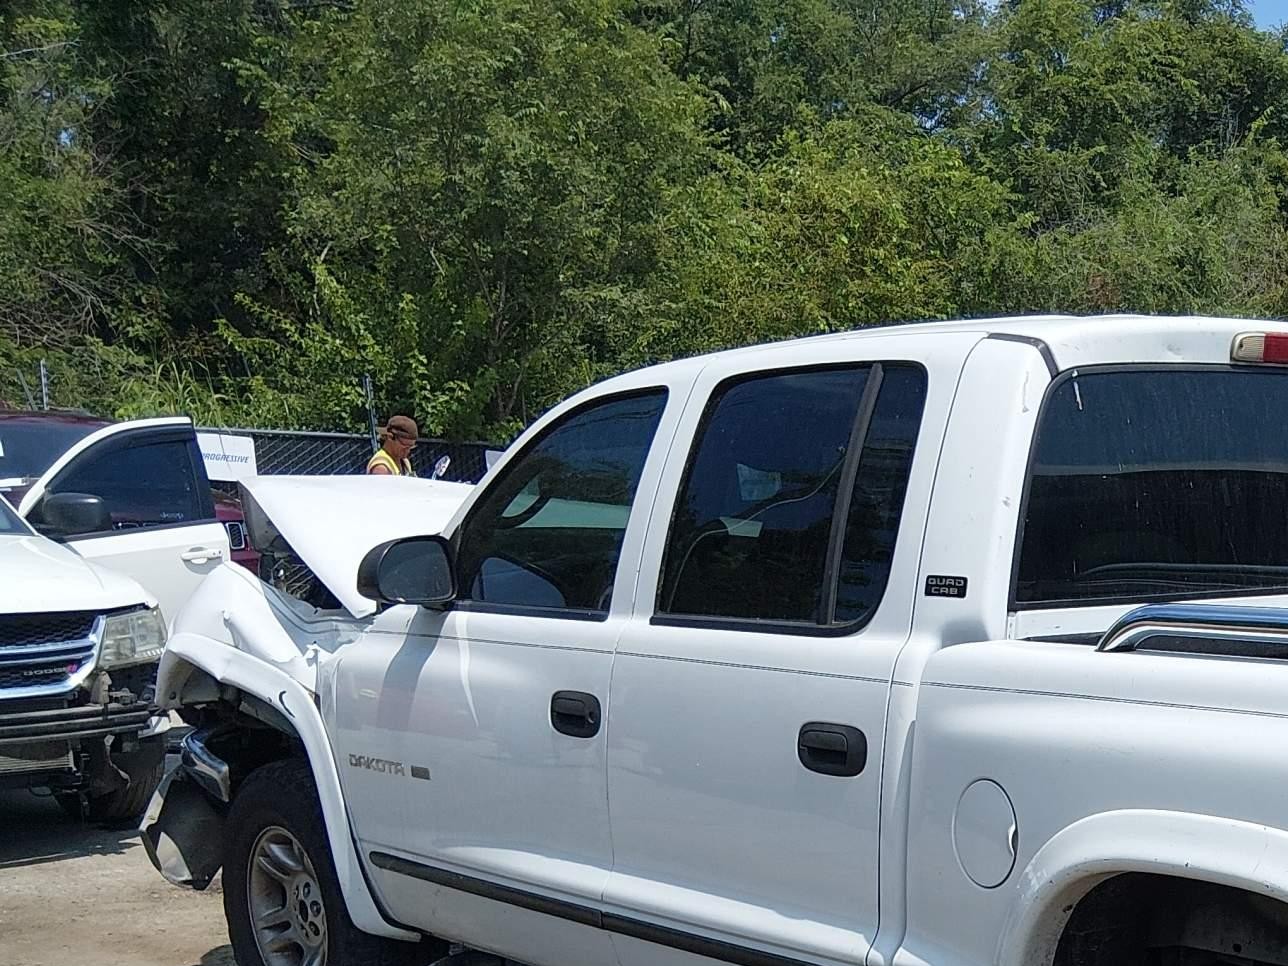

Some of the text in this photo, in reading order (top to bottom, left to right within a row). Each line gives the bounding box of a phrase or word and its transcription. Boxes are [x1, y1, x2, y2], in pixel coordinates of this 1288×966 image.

[928, 577, 965, 587] QUAD
[931, 586, 959, 595] CAB
[348, 753, 406, 777] DAKOTA
